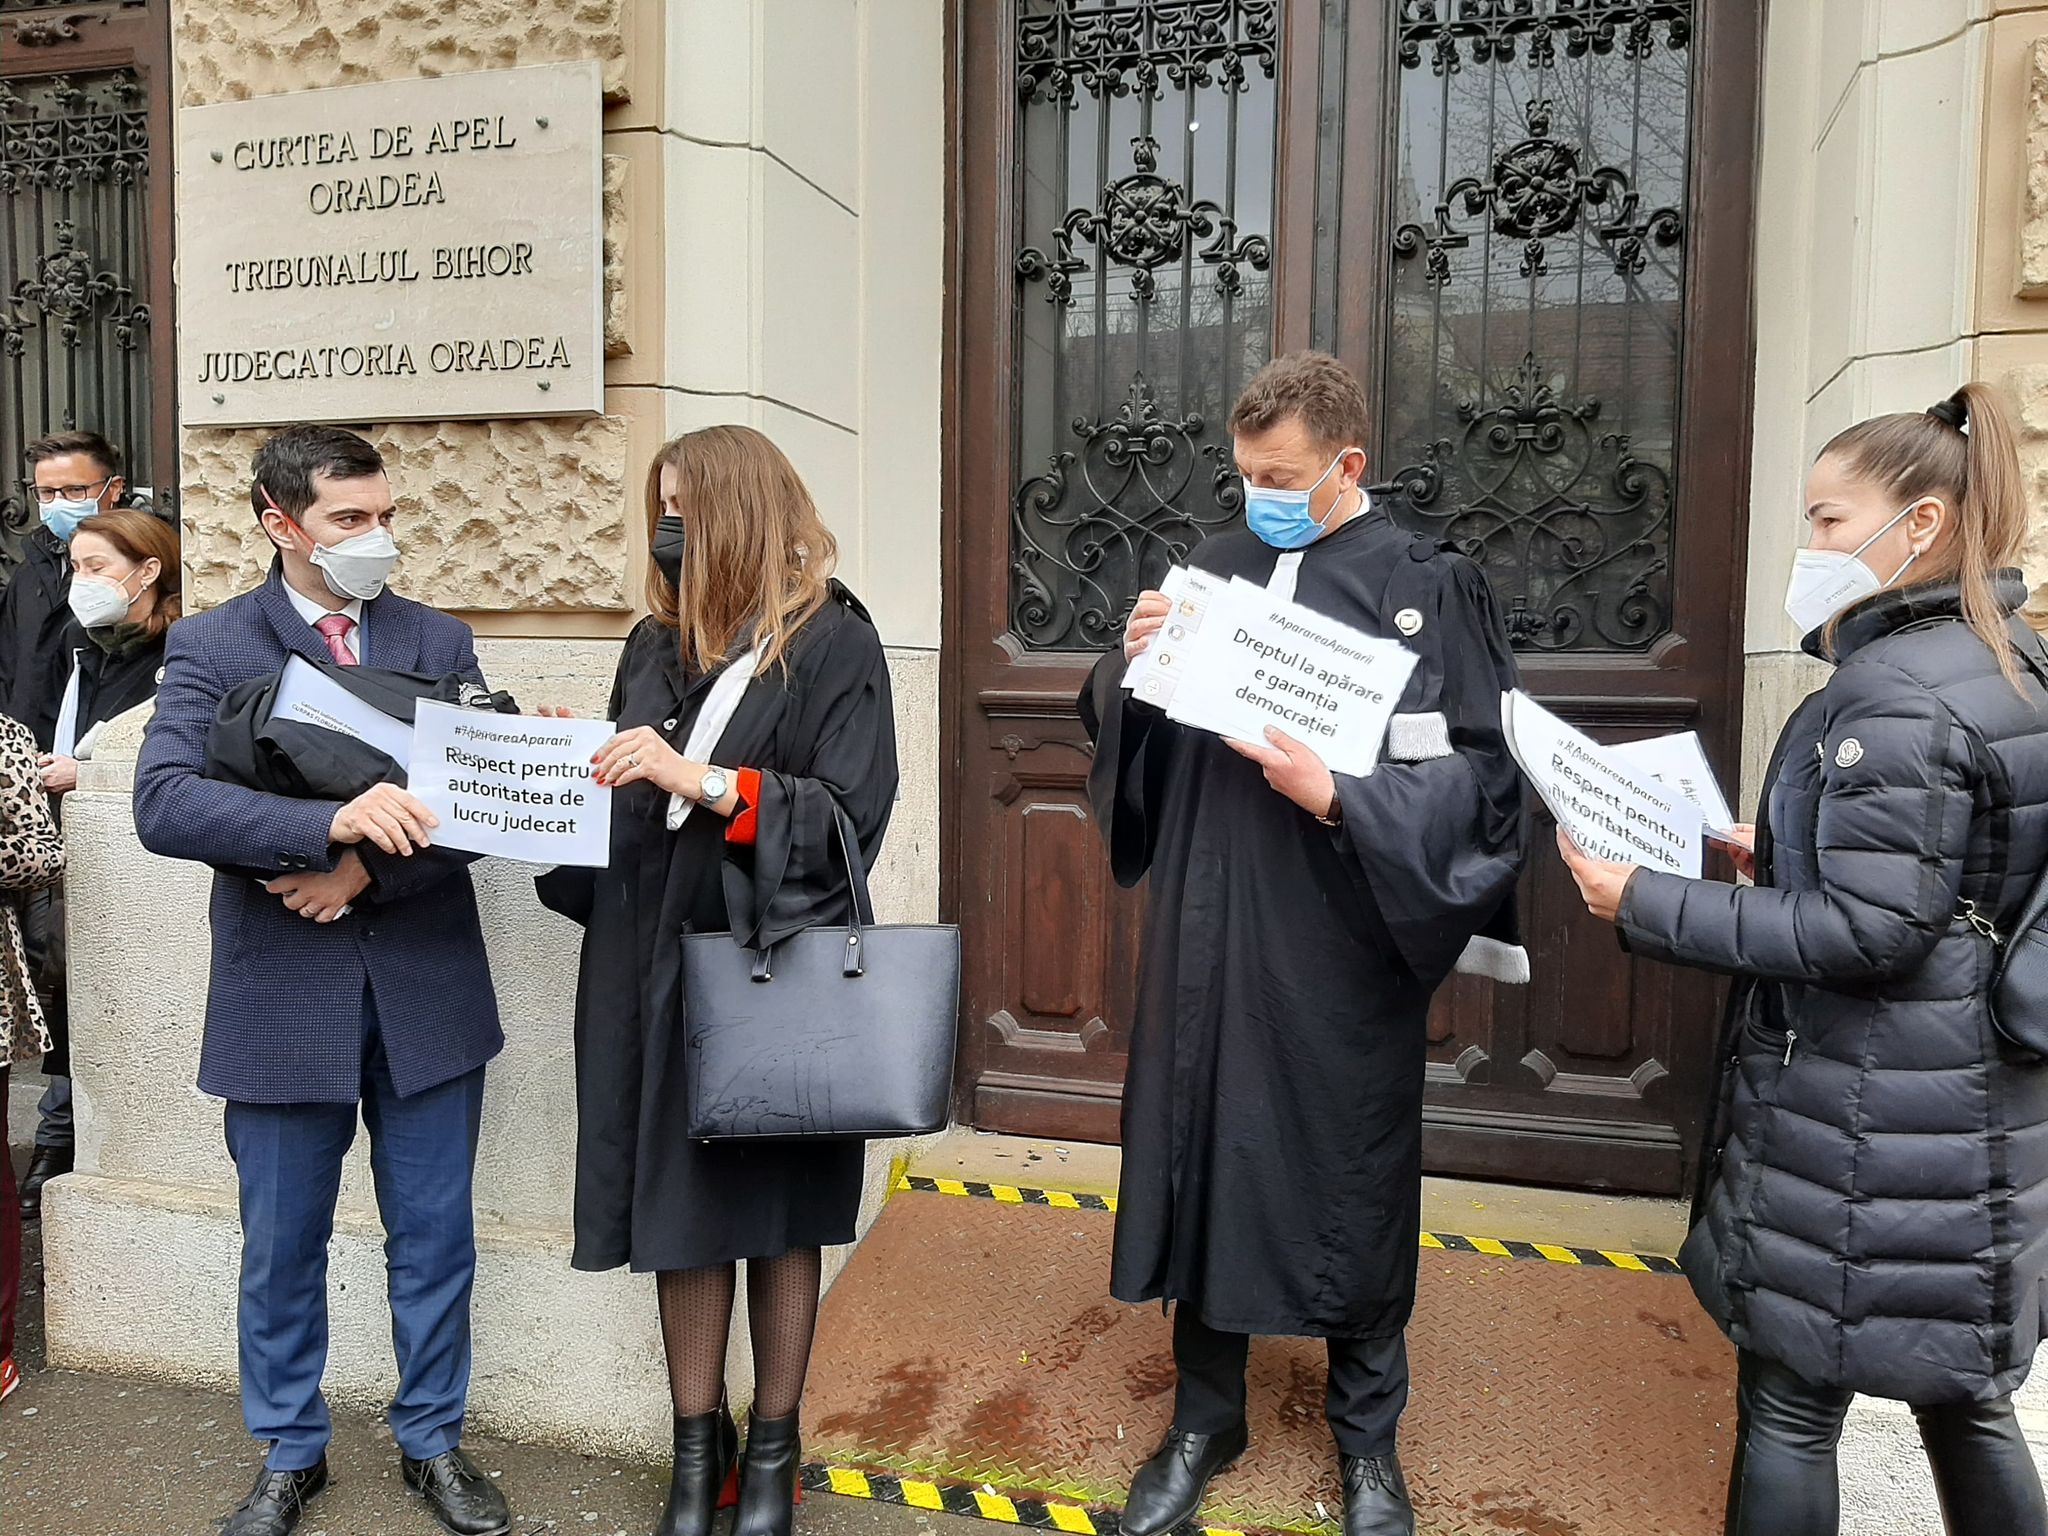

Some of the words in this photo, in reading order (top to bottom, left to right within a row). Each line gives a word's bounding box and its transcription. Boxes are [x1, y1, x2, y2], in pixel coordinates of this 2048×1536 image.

[233, 130, 358, 171] CURTEA
[370, 124, 414, 158] DE
[425, 116, 517, 154] APEL
[307, 171, 446, 215] ORADEA
[225, 249, 419, 292] TRIBUNALUL
[432, 242, 534, 280] BIHOR
[197, 343, 417, 383] JUDECATORIA
[428, 336, 571, 373] ORADEA
[1268, 612, 1375, 665] #AparareaApararii
[1233, 628, 1299, 667] Dreptul
[1299, 657, 1315, 675] la
[1317, 669, 1384, 704] apărare
[1254, 668, 1265, 681] e
[1265, 674, 1339, 712] garanția
[1235, 685, 1339, 737] democrației
[445, 746, 516, 775] Respect
[521, 762, 590, 780] pentru
[448, 778, 554, 806] autoritatea
[560, 789, 585, 806] de
[1551, 753, 1622, 812] Respect
[1625, 805, 1686, 849] pentru
[453, 802, 499, 826] lucru
[501, 811, 577, 834] judecat
